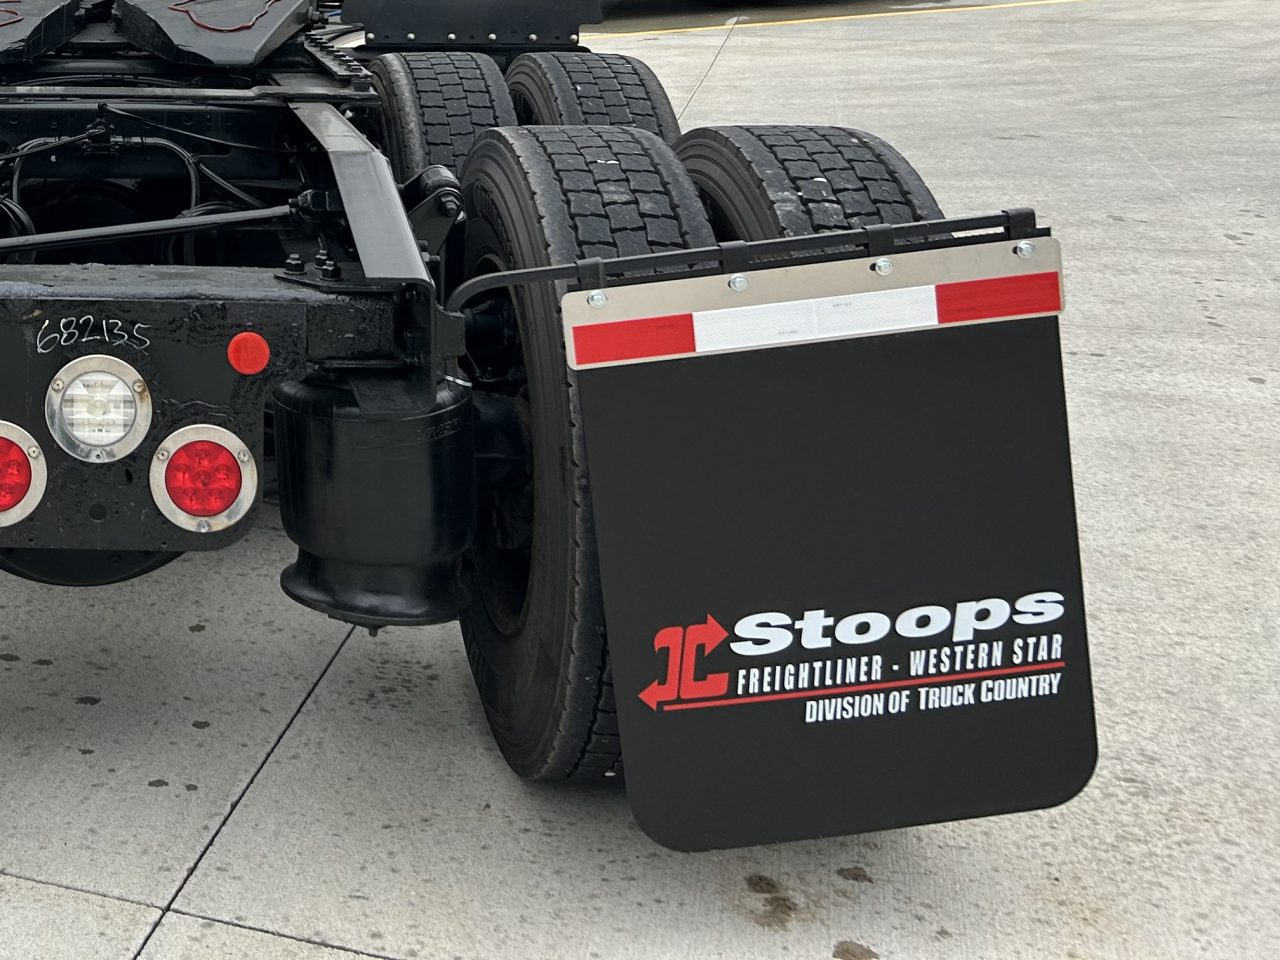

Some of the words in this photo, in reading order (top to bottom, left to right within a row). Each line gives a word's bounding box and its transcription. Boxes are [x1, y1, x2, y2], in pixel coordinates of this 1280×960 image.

[36, 314, 152, 355] 682135
[729, 591, 1065, 656] Stoops
[737, 654, 883, 695] FREIGHTLINER
[909, 640, 1003, 677] WESTERN
[1012, 633, 1063, 665] STAR
[805, 692, 885, 723] DIVISION
[887, 689, 911, 714] OF
[917, 682, 976, 711] TRUCK
[980, 672, 1062, 703] COUNTRY
